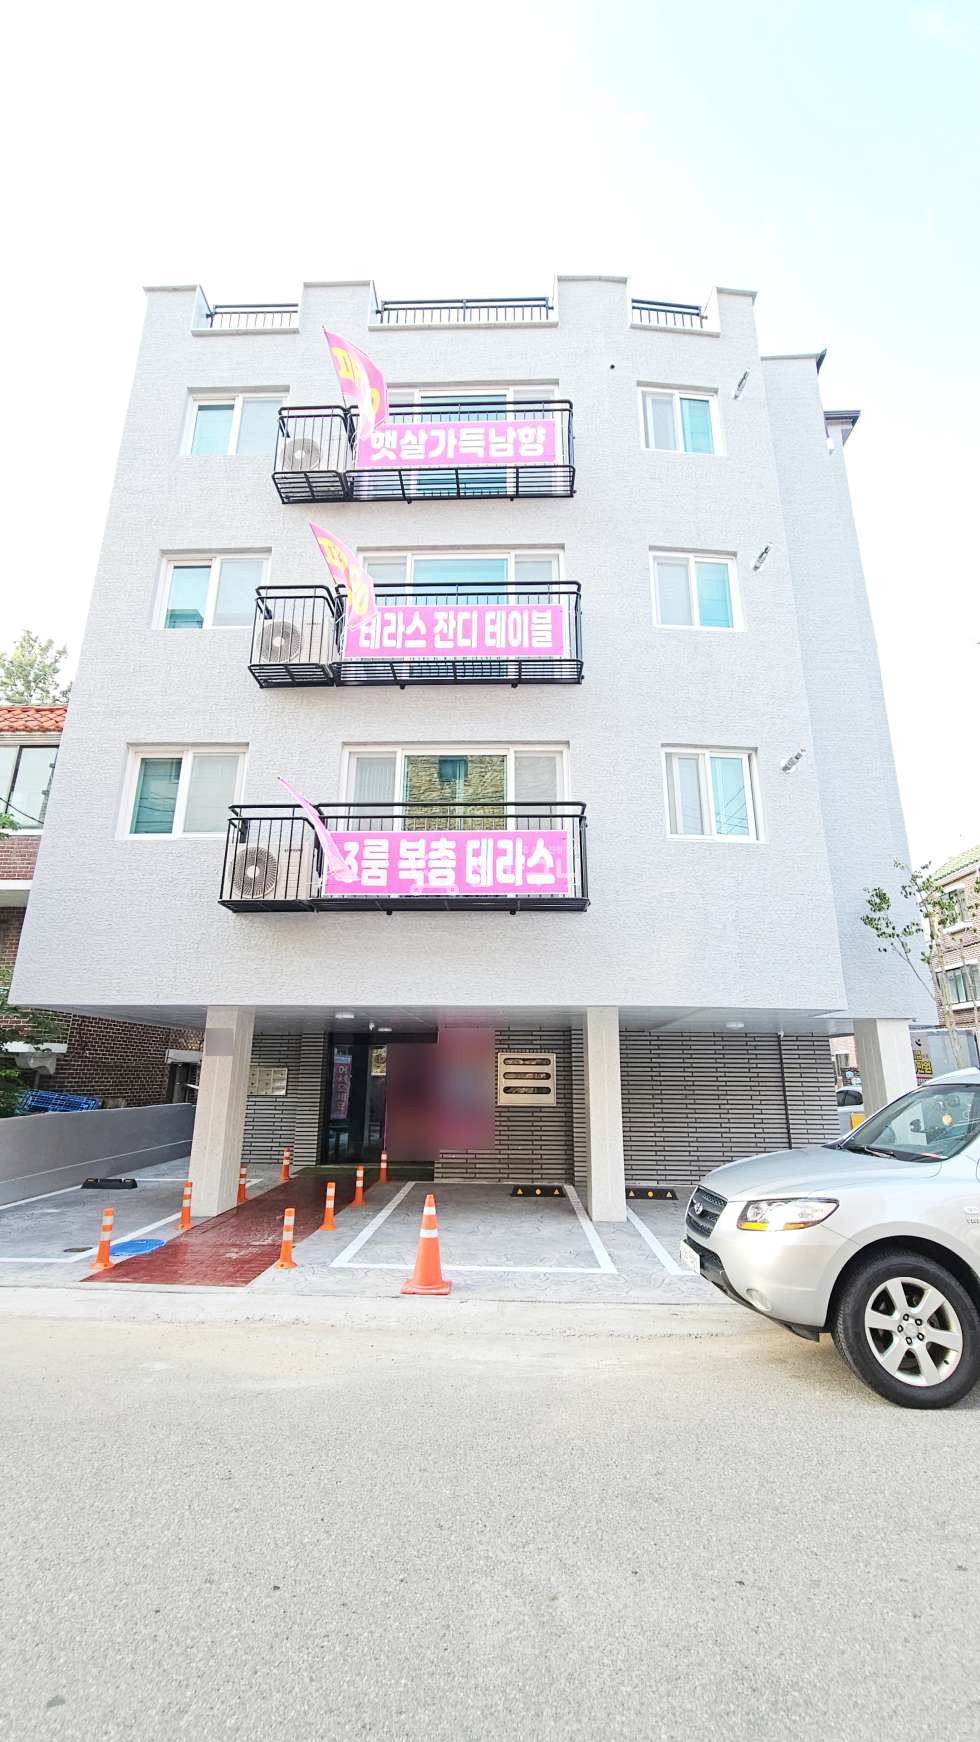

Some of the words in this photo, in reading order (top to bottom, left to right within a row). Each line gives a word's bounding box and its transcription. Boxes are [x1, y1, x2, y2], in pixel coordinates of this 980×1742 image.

[369, 427, 546, 461] 햇살가득남향
[358, 609, 427, 649] 테라스
[433, 610, 478, 649] 잔디
[484, 608, 553, 649] 테이블
[397, 837, 457, 887] 복층
[466, 837, 556, 887] 테라스
